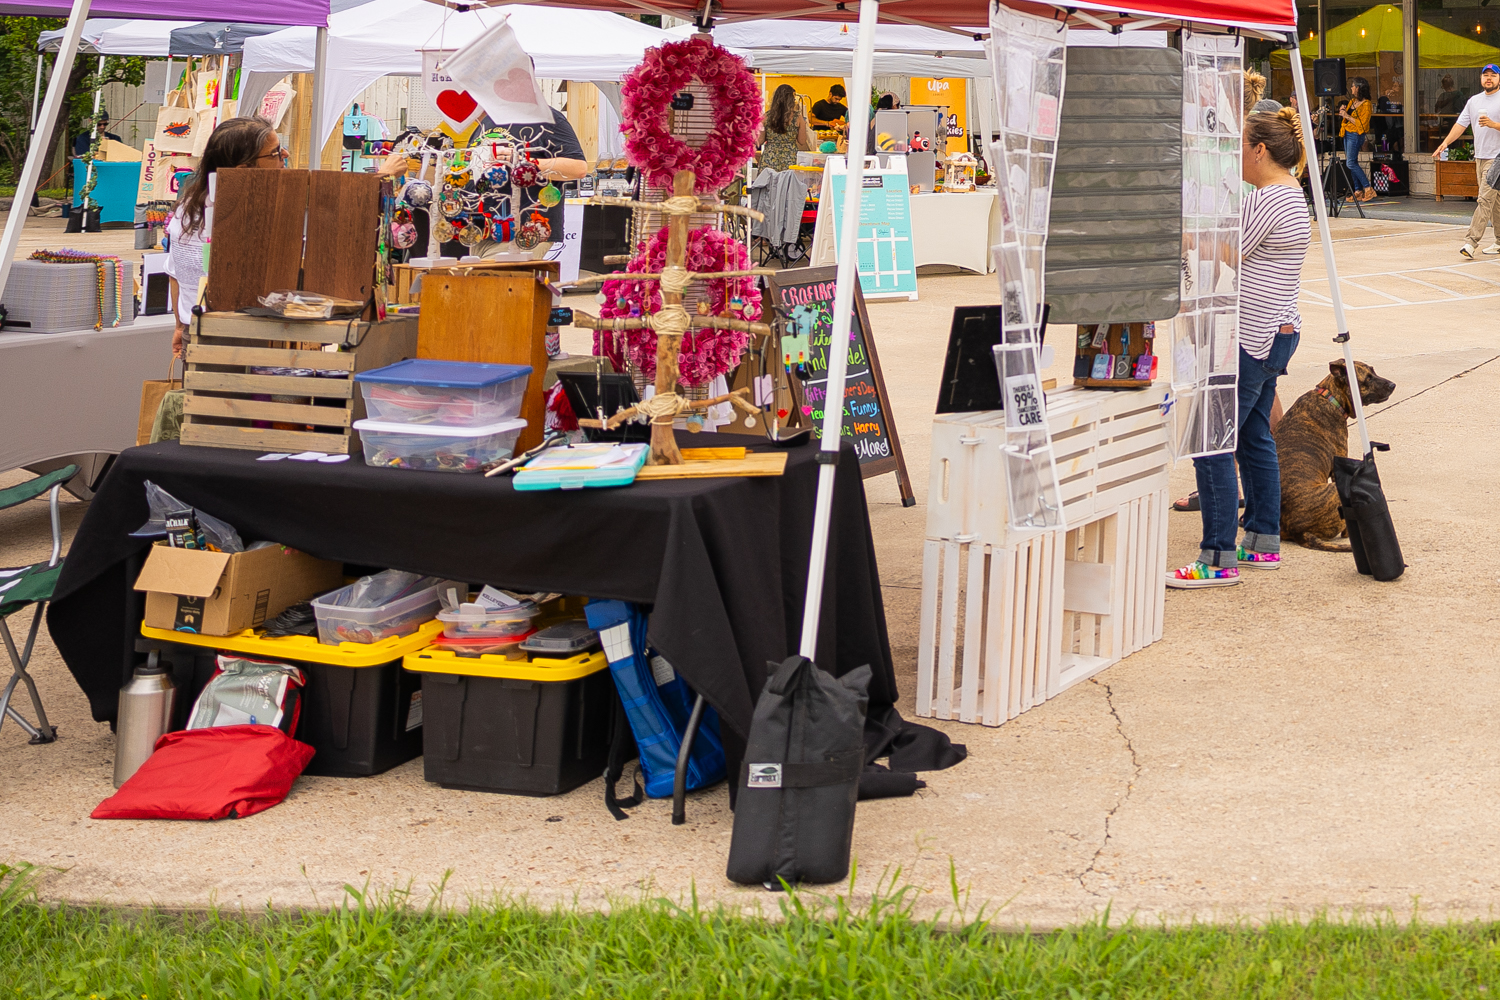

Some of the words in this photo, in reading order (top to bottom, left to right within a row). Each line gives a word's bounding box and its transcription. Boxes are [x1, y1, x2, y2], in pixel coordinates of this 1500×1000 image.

[927, 80, 949, 92] Upa
[1014, 391, 1038, 408] 99%
[1019, 411, 1043, 426] CARE
[853, 421, 881, 437] Harry
